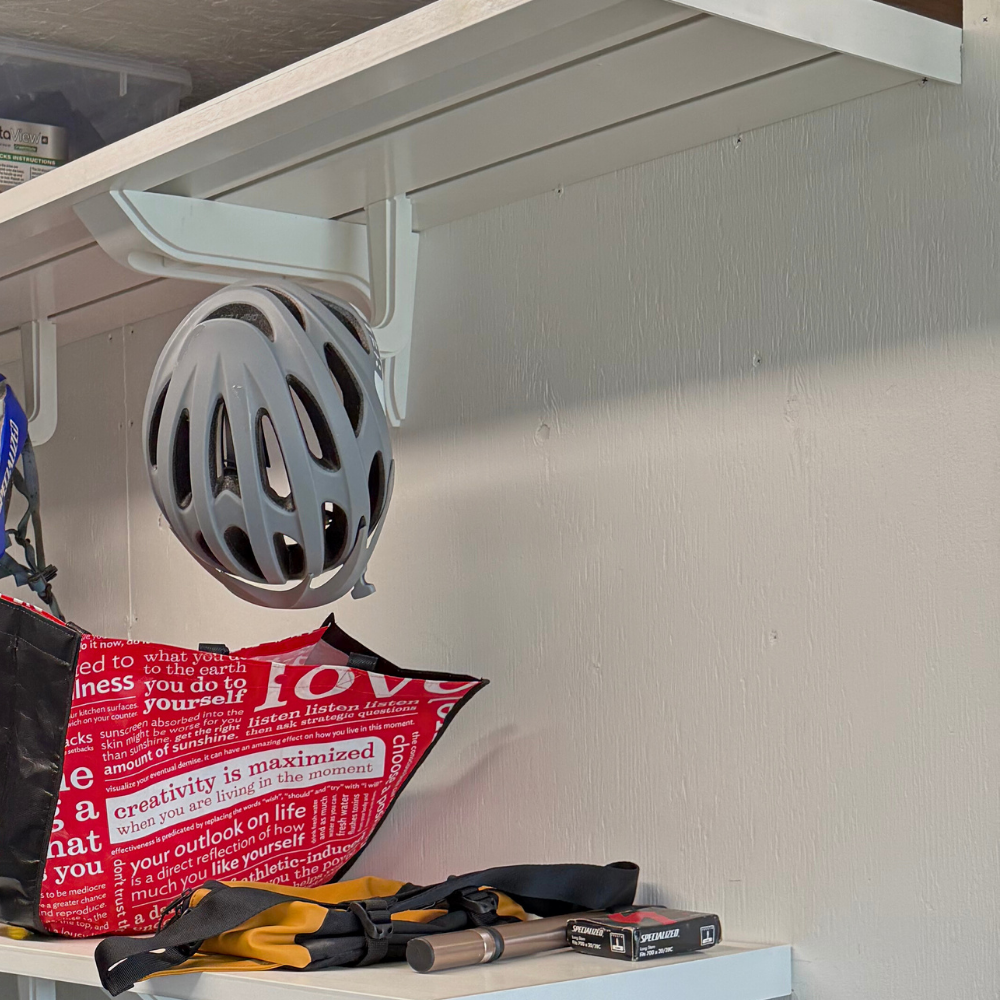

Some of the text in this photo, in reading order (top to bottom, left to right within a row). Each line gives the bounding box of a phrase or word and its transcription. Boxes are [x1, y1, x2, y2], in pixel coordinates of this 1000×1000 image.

[13, 156, 55, 166] INSTRUCTIONS
[90, 640, 97, 648] it
[112, 656, 134, 669] to
[144, 650, 188, 662] what
[144, 661, 246, 676] to the earth
[72, 675, 134, 699] lness
[144, 676, 246, 696] you do to
[79, 706, 105, 716] kitchen
[143, 689, 247, 714] yourself
[94, 715, 109, 723] your
[246, 705, 417, 736] then ask strategic questions
[249, 699, 419, 728] listen listen listen
[100, 720, 148, 739] sunscreen
[151, 713, 200, 727] absorbed
[101, 718, 241, 750] skin might be worse for you
[102, 725, 240, 761] than sunshine. get the right
[412, 731, 420, 744] the
[104, 732, 238, 775] amount of sunshine.
[106, 780, 136, 792] visualize
[137, 776, 149, 787] your
[150, 764, 177, 779] eventual
[211, 751, 222, 760] can
[252, 738, 281, 749] amazing
[282, 734, 302, 743] effect
[315, 731, 331, 739] how
[333, 730, 345, 738] you
[347, 726, 359, 734] live
[369, 723, 382, 731] this
[384, 720, 415, 729] moment.
[114, 775, 216, 820] creativity
[224, 766, 241, 784] is
[249, 741, 375, 777] maximized
[117, 763, 373, 835] when you are living in the moment
[76, 800, 99, 822] a
[321, 817, 326, 825] as
[336, 794, 349, 836] fresh water
[111, 840, 155, 856] effectiveness
[162, 824, 194, 842] predicated
[205, 812, 232, 826] replacing
[243, 801, 261, 810] words
[348, 814, 358, 835] flushes
[130, 803, 306, 876] your outlook on life
[131, 822, 305, 886] is a direct reflection of how
[54, 860, 104, 884] you
[132, 833, 305, 901] much you like yourself
[294, 865, 318, 880] the
[69, 883, 106, 895] mediocre
[114, 859, 126, 918] don't trust
[53, 900, 79, 909] greater
[81, 893, 106, 904] chance
[56, 903, 107, 916] reproduce.
[94, 912, 107, 921] the
[94, 922, 109, 930] and
[135, 913, 145, 925] a
[572, 925, 604, 937] SPECIALIZED
[640, 928, 680, 943] SPECIALIZED
